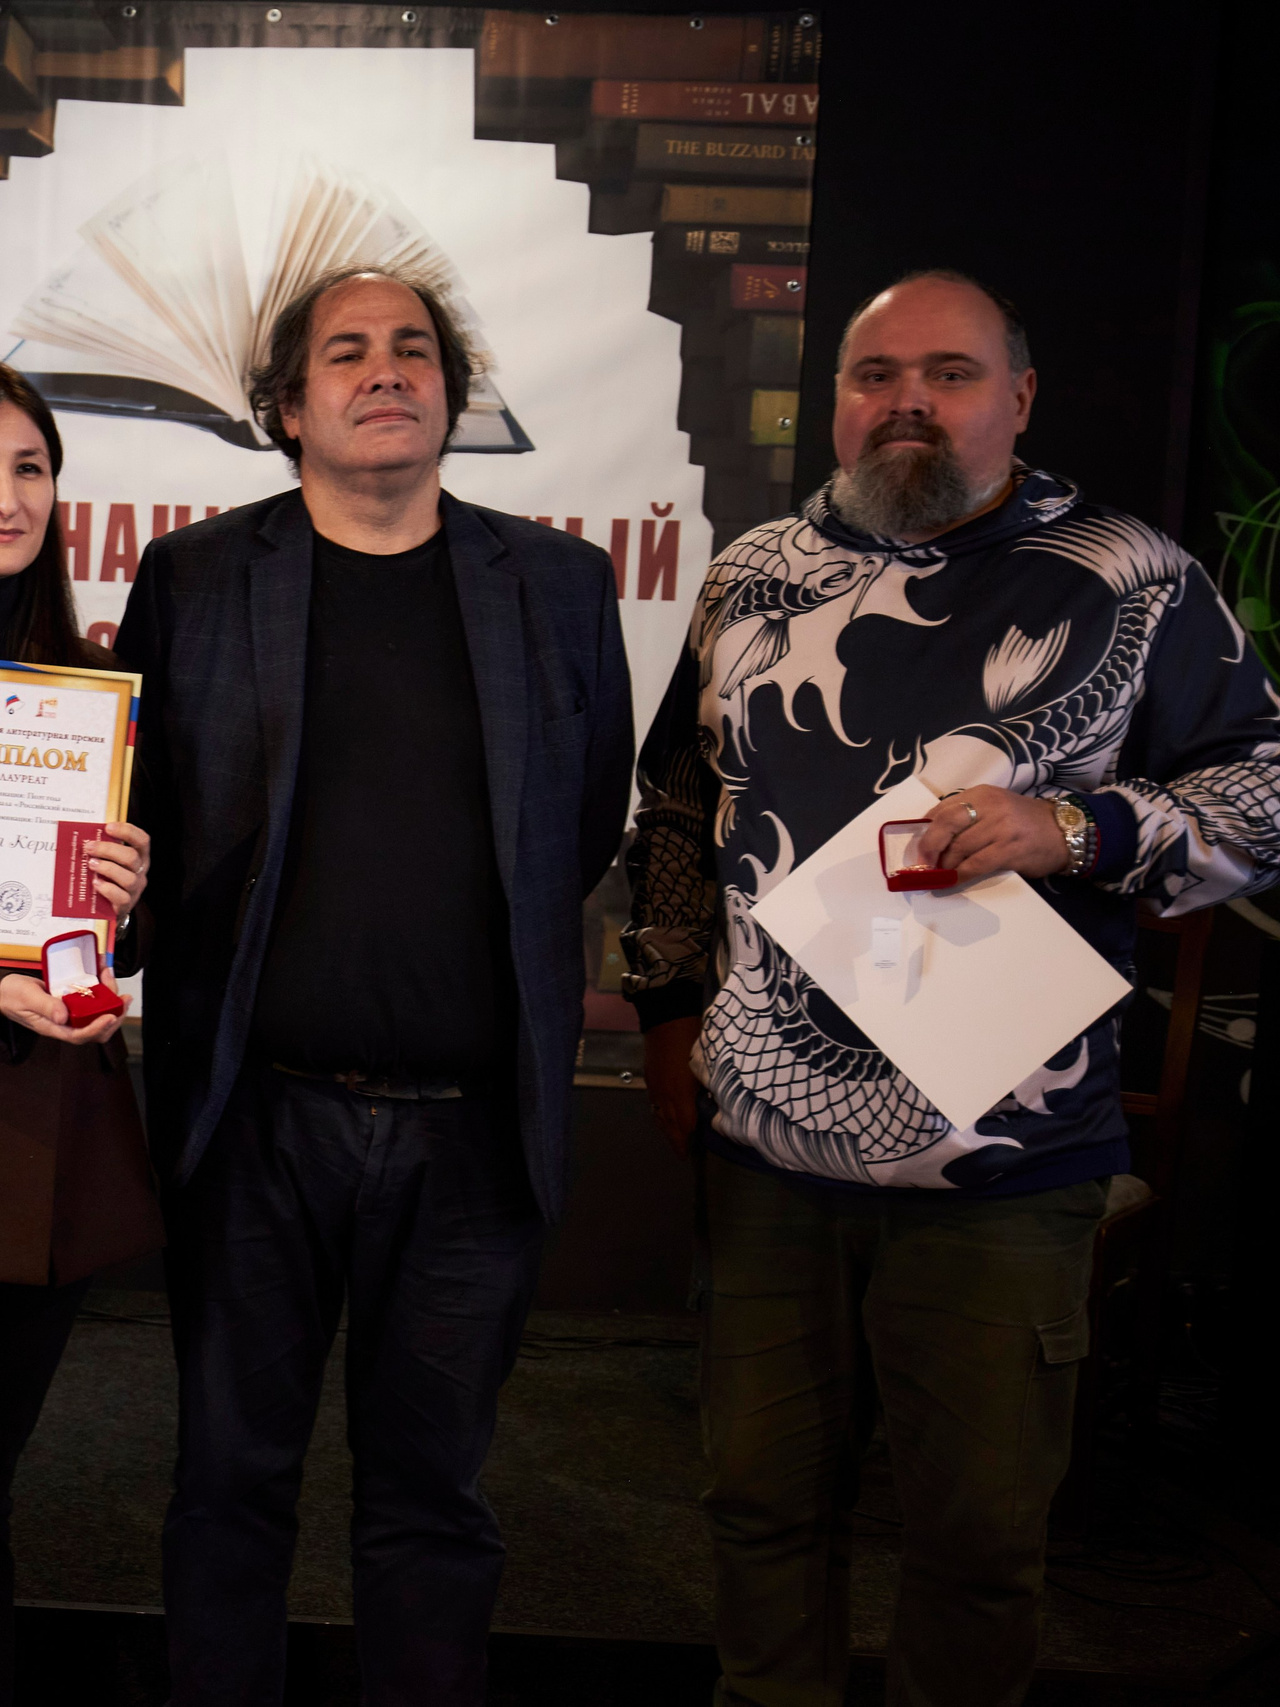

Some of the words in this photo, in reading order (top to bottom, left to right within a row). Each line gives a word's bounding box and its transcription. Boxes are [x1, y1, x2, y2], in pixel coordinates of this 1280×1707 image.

[665, 139, 701, 155] THE
[705, 141, 786, 159] BUZZARD
[6, 729, 69, 741] литературная
[71, 734, 105, 744] премия
